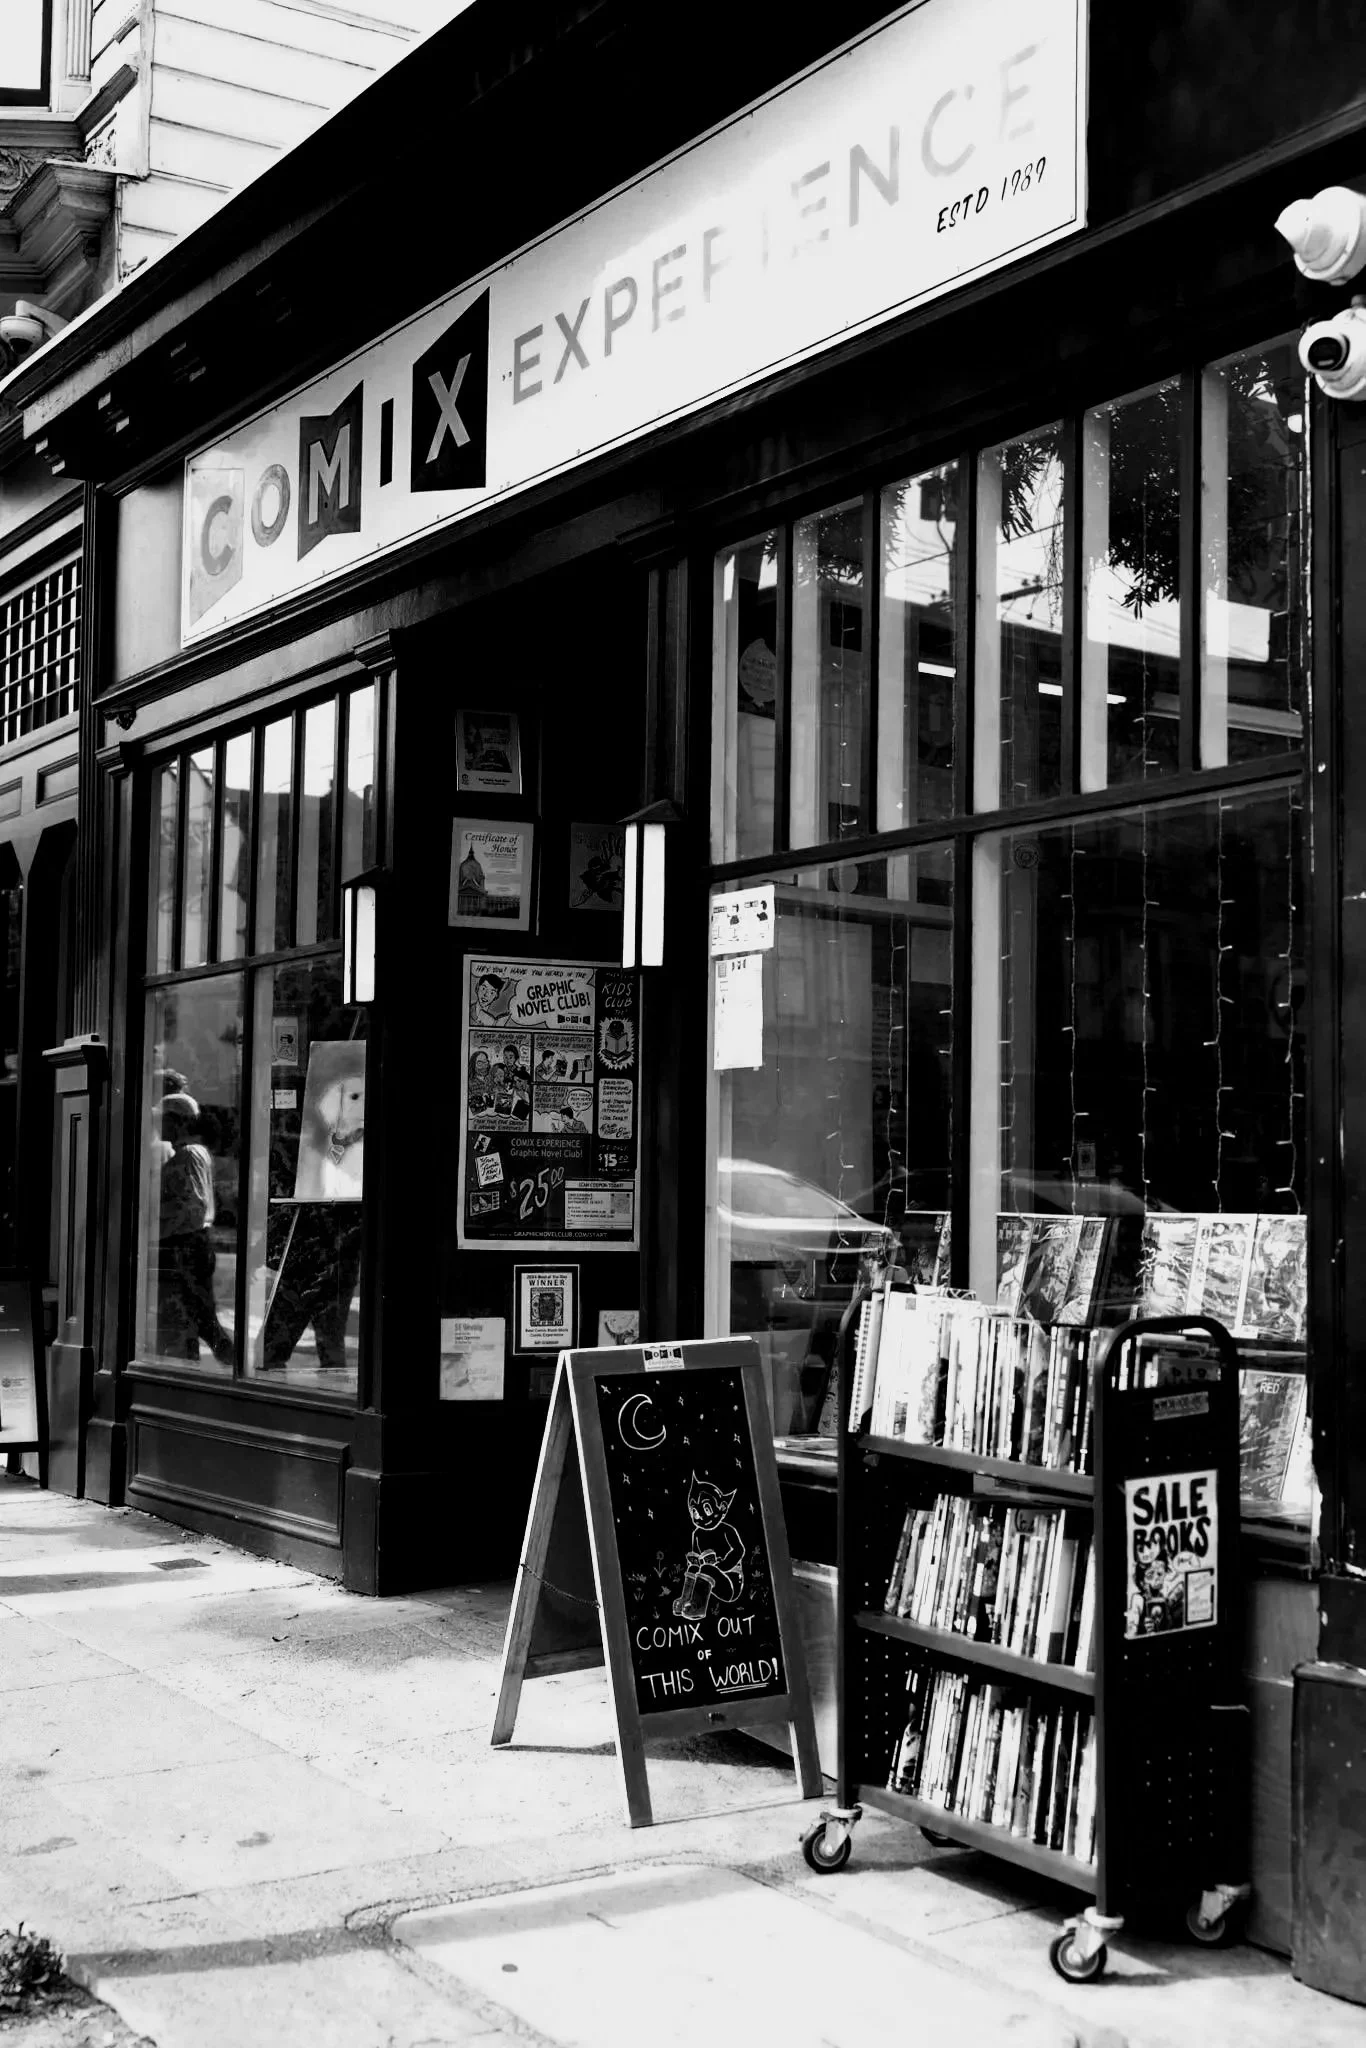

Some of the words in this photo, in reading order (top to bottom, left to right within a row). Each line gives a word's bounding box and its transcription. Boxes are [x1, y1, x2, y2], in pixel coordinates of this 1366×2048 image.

[936, 186, 990, 234] ESTD
[1001, 155, 1048, 205] 1989
[201, 352, 472, 577] COMIX
[465, 832, 508, 844] Certificate
[508, 833, 519, 845] of
[491, 843, 518, 853] Honor
[526, 979, 576, 1001] GRAPHIC
[601, 982, 634, 997] KIDS
[516, 998, 556, 1018] NOVEL
[557, 992, 591, 1011] CLUB!
[605, 996, 633, 1008] CLUB
[511, 1138, 535, 1148] COMIX
[536, 1138, 581, 1149] EXPERIENCE
[510, 1148, 538, 1158] Graphic
[539, 1148, 562, 1158] Novel
[563, 1149, 583, 1158] Club!
[1259, 1382, 1280, 1394] RED
[1132, 1477, 1208, 1526] SALE
[1132, 1515, 1212, 1561] BOOKS
[636, 1621, 704, 1651] COMIX
[717, 1613, 756, 1638] OUT
[697, 1648, 713, 1661] OF
[641, 1667, 695, 1700] THIS
[709, 1657, 780, 1690] WORLD!
